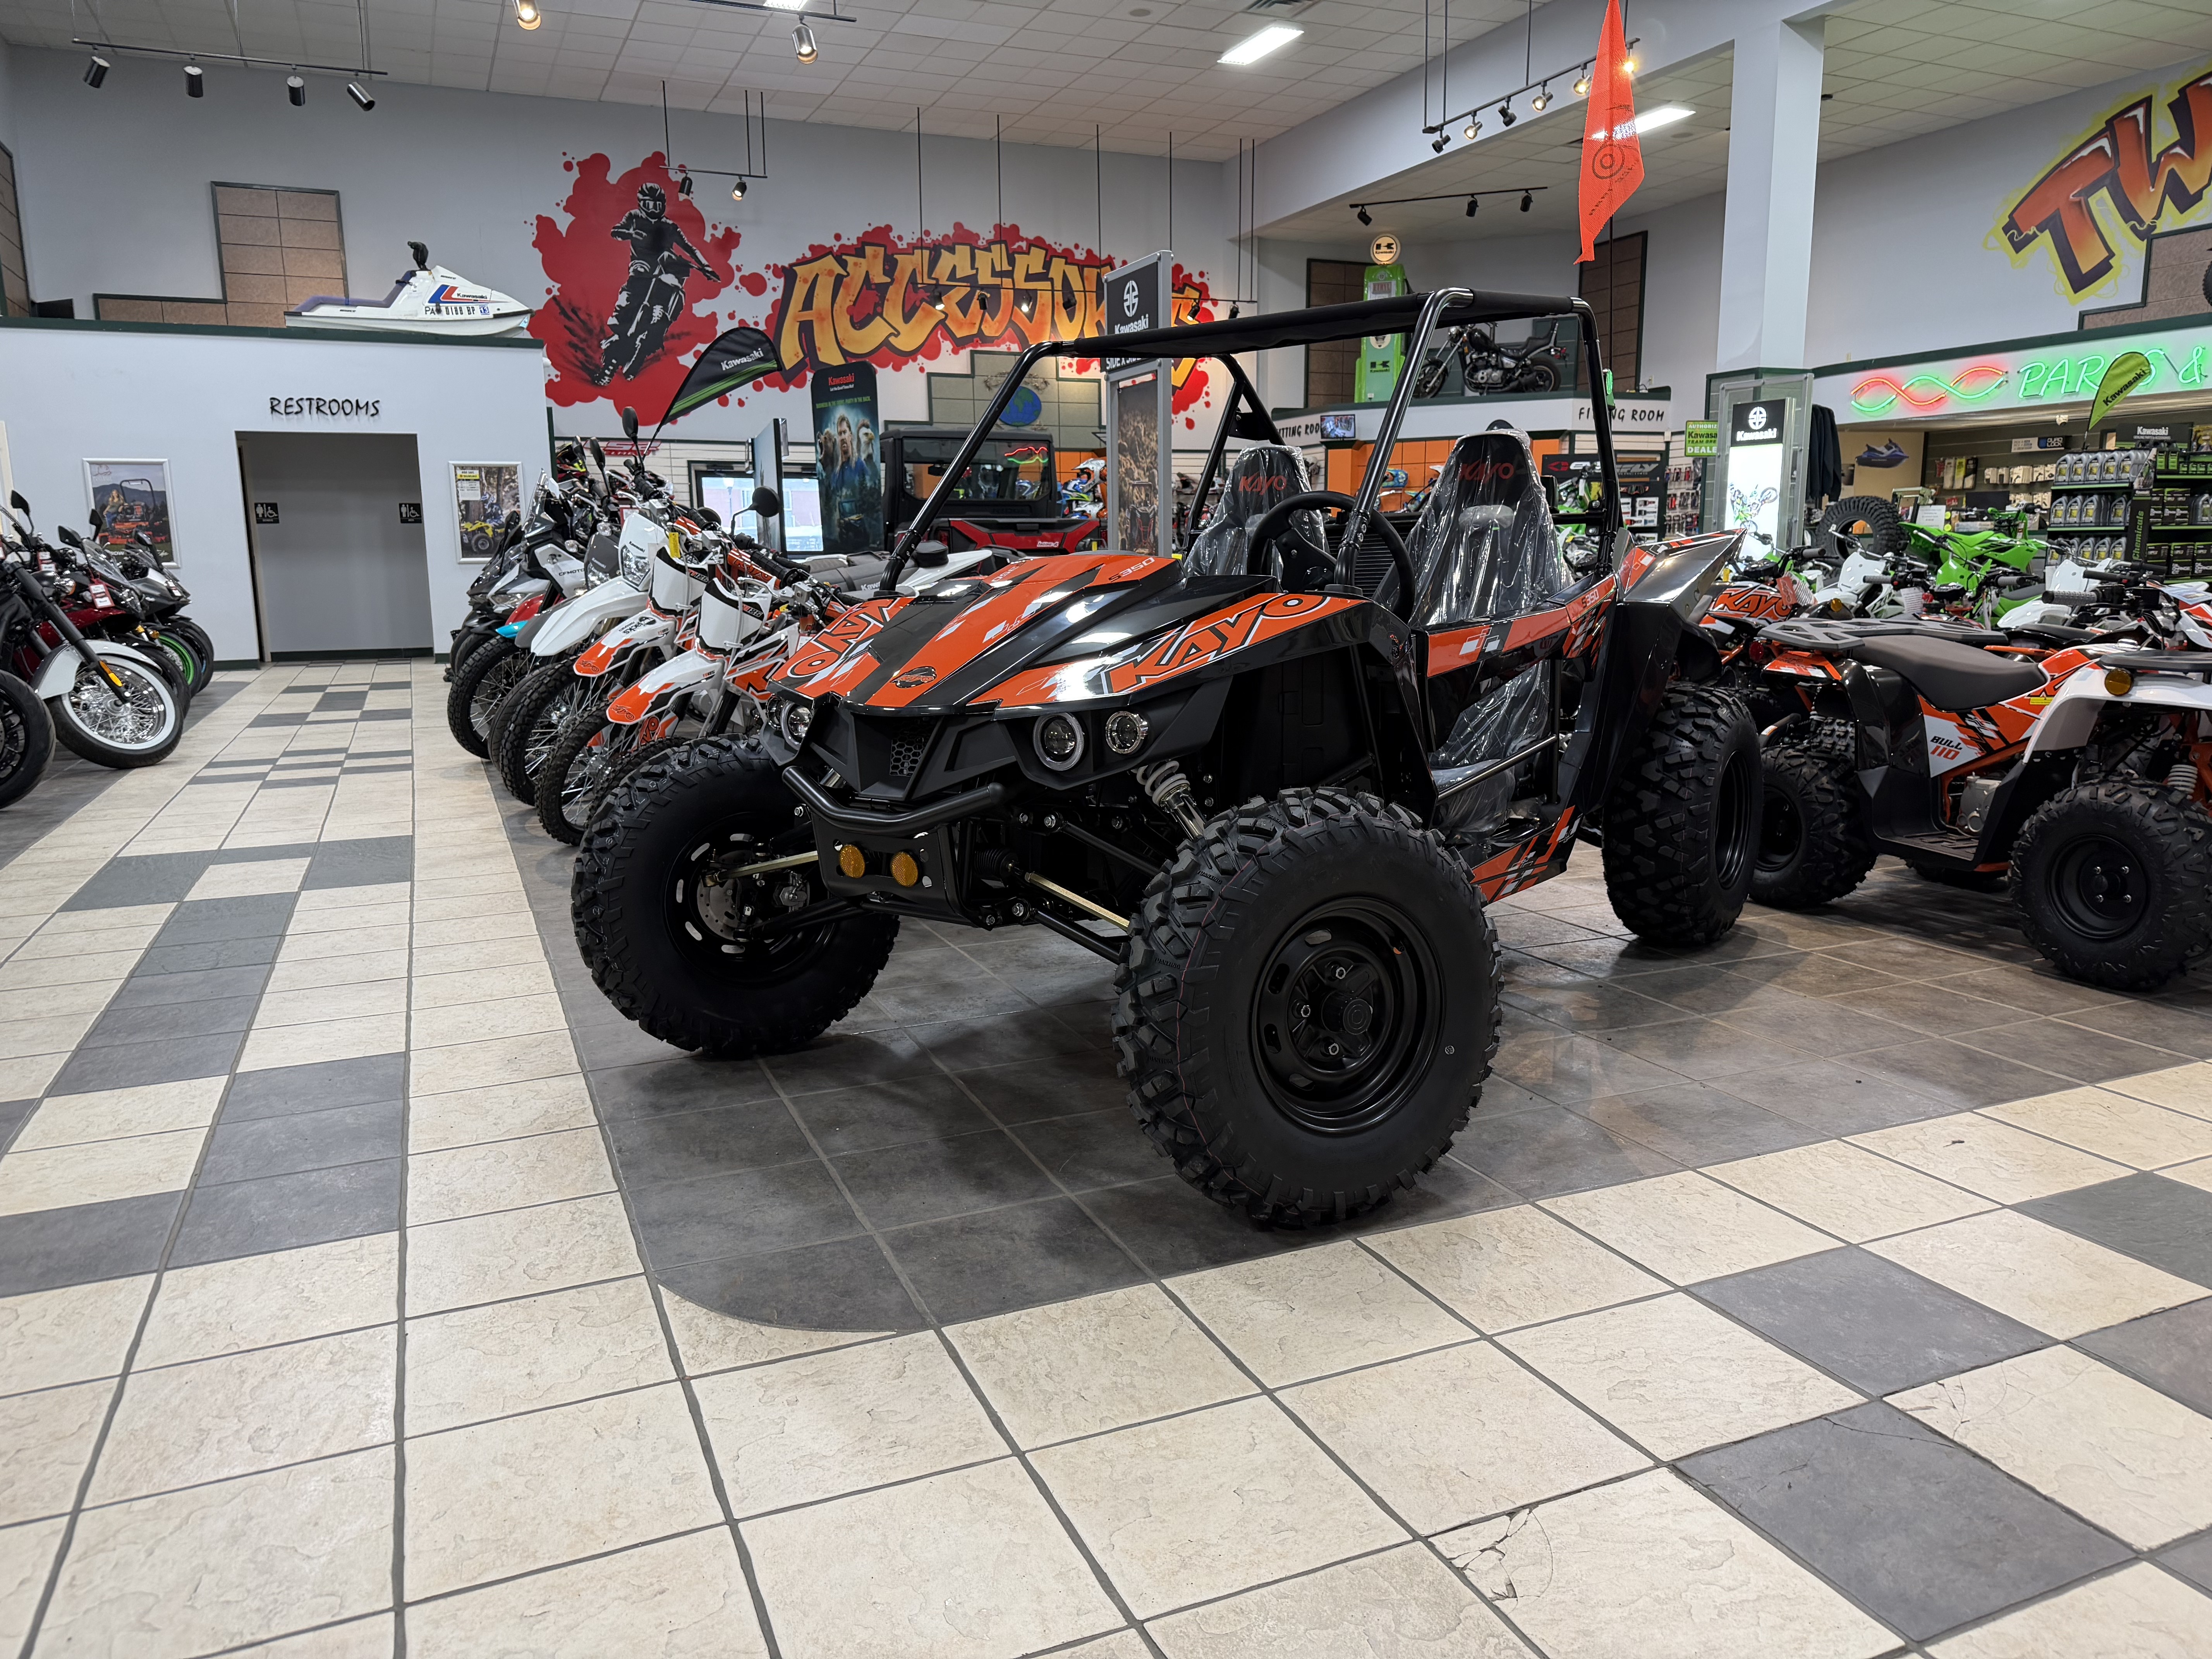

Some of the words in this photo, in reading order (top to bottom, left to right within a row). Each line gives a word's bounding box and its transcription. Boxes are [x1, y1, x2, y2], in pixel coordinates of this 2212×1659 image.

[425, 306, 436, 315] PA
[1114, 314, 1149, 335] Kawasaki
[721, 348, 764, 371] Kawasaki
[828, 373, 855, 386] Kawasaki
[2017, 348, 2165, 398] PARS
[2179, 345, 2204, 383] &
[2102, 368, 2147, 406] Kawasaki
[269, 397, 381, 417] RESTROOMS
[1579, 407, 1625, 422] FING
[1631, 409, 1664, 422] ROOM
[1277, 424, 1302, 438] ITTING
[1305, 423, 1320, 436] ROO
[1736, 428, 1777, 441] Kawasaki
[2137, 426, 2169, 436] Kawasaki
[1459, 459, 1514, 483] KAYO
[1238, 471, 1287, 495] KAYO
[2132, 510, 2144, 560] Chemicals
[629, 541, 646, 553] Kawasaki
[591, 557, 607, 568] Kawasaki
[1108, 557, 1155, 583] S350
[1581, 589, 1599, 609] S350
[1714, 588, 1793, 619] KAYO
[787, 598, 902, 678] KAYO
[1101, 593, 1332, 694] KAYO
[1930, 735, 1963, 750] BULL
[1930, 745, 1960, 761] 110
